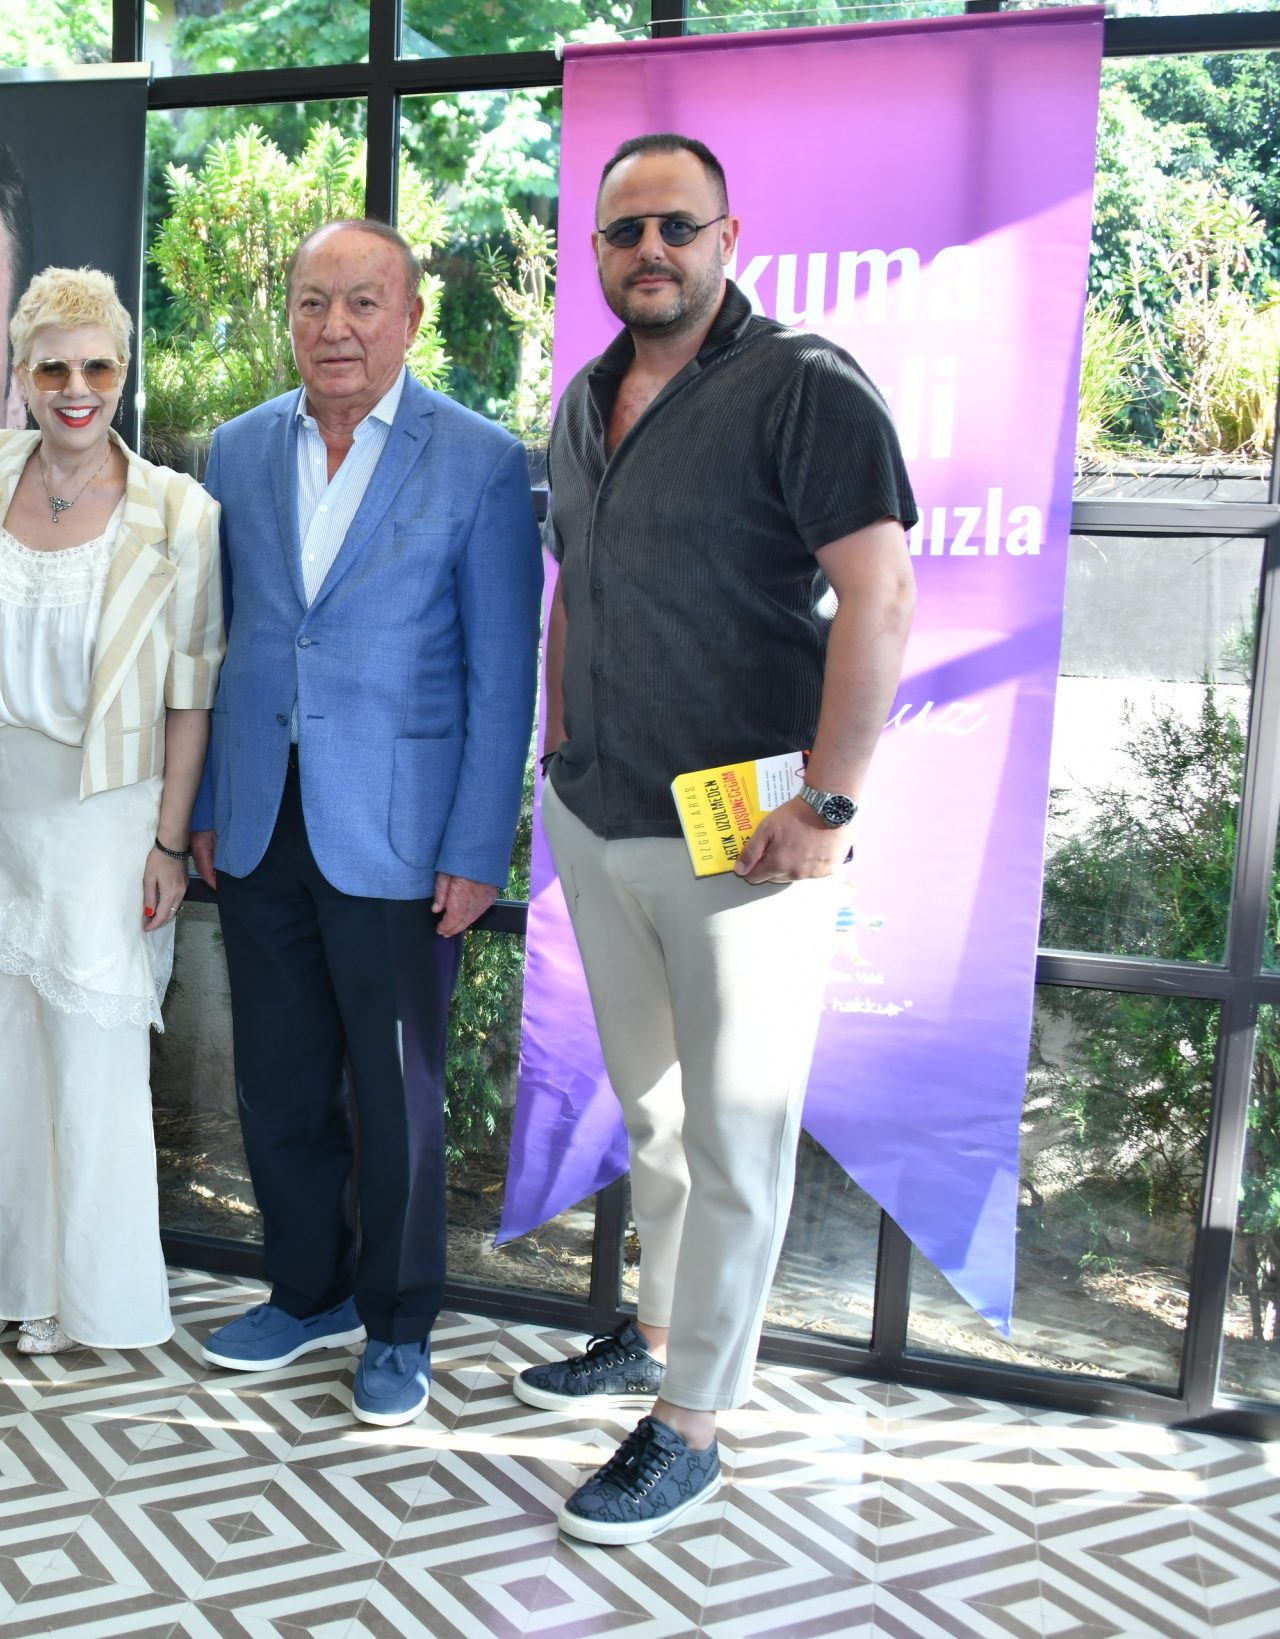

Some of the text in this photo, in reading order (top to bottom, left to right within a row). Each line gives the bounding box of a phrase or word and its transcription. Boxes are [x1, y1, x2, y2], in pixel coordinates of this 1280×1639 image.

[723, 238, 983, 327] kuma
[881, 699, 991, 737] uz
[684, 786, 702, 816] ARAS
[703, 779, 741, 861] ARTIK ÜZÜLMEDEN
